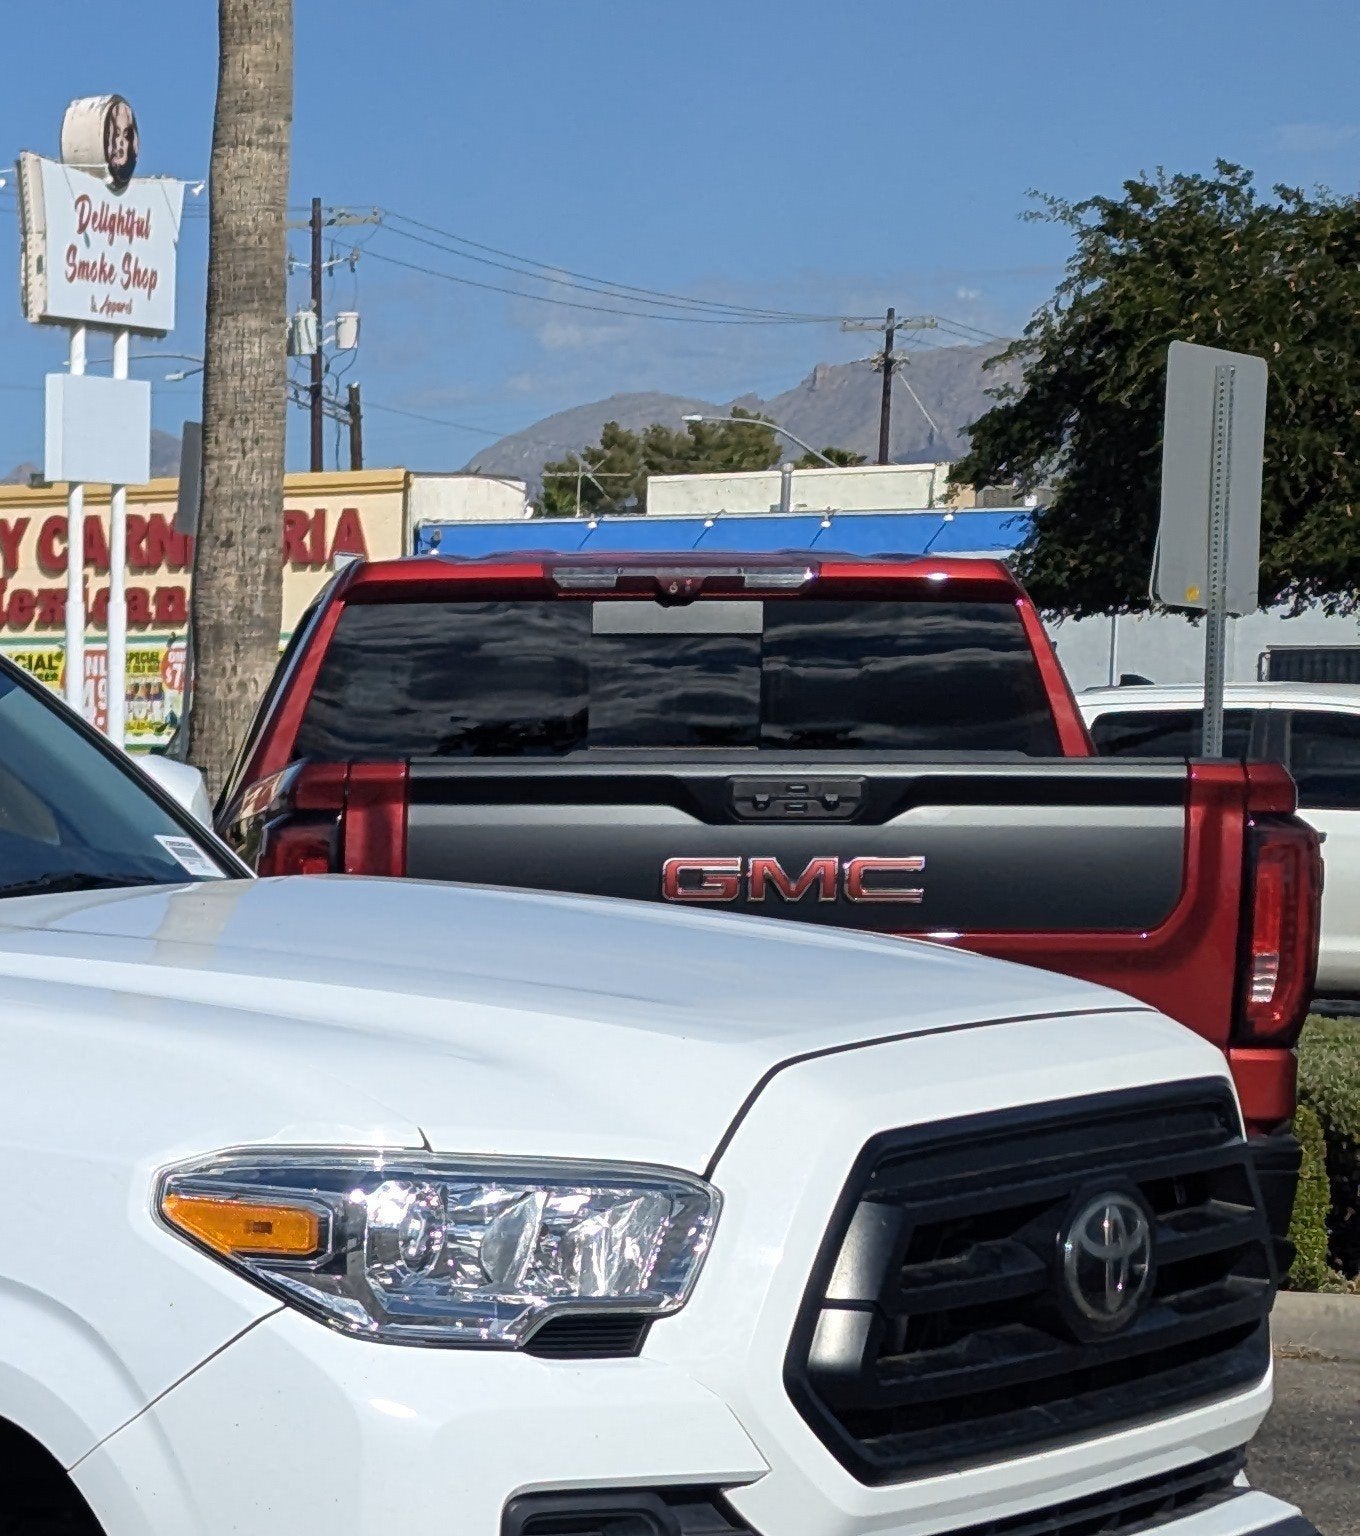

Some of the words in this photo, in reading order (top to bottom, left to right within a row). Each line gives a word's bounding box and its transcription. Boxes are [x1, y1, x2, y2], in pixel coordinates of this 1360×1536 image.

[74, 193, 152, 247] Delightful
[64, 243, 117, 285] Smoke
[120, 251, 159, 301] Shop
[661, 855, 926, 902] GMC
